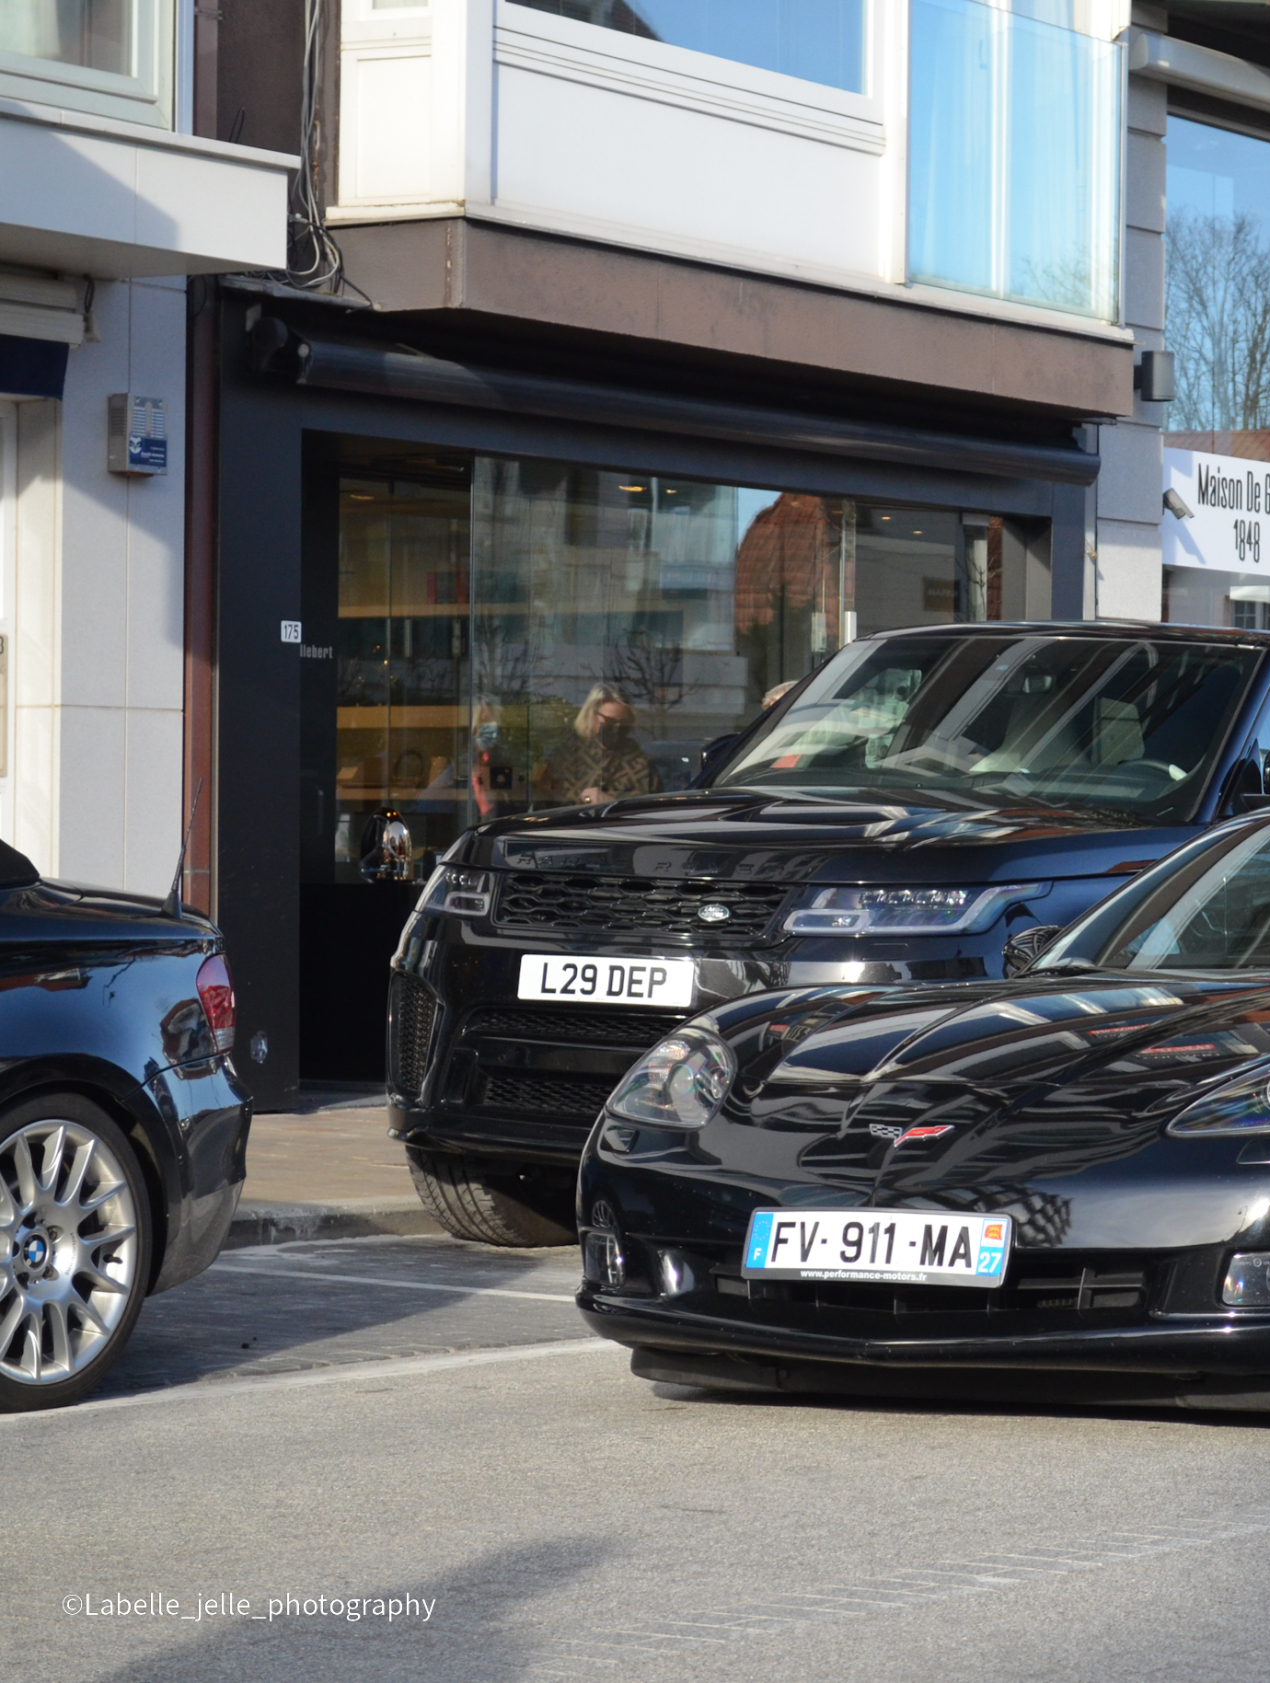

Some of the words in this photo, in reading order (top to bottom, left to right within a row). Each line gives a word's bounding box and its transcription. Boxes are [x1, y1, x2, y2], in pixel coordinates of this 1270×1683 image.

[1197, 463, 1243, 511] Maison
[1246, 470, 1261, 513] De
[1233, 519, 1260, 563] 1848
[284, 624, 299, 640] 175
[541, 962, 598, 995] L29
[606, 965, 667, 998] DEP
[753, 1248, 761, 1261] F
[979, 1252, 1002, 1273] 27
[800, 1268, 928, 1282] www.performance-motors.fr
